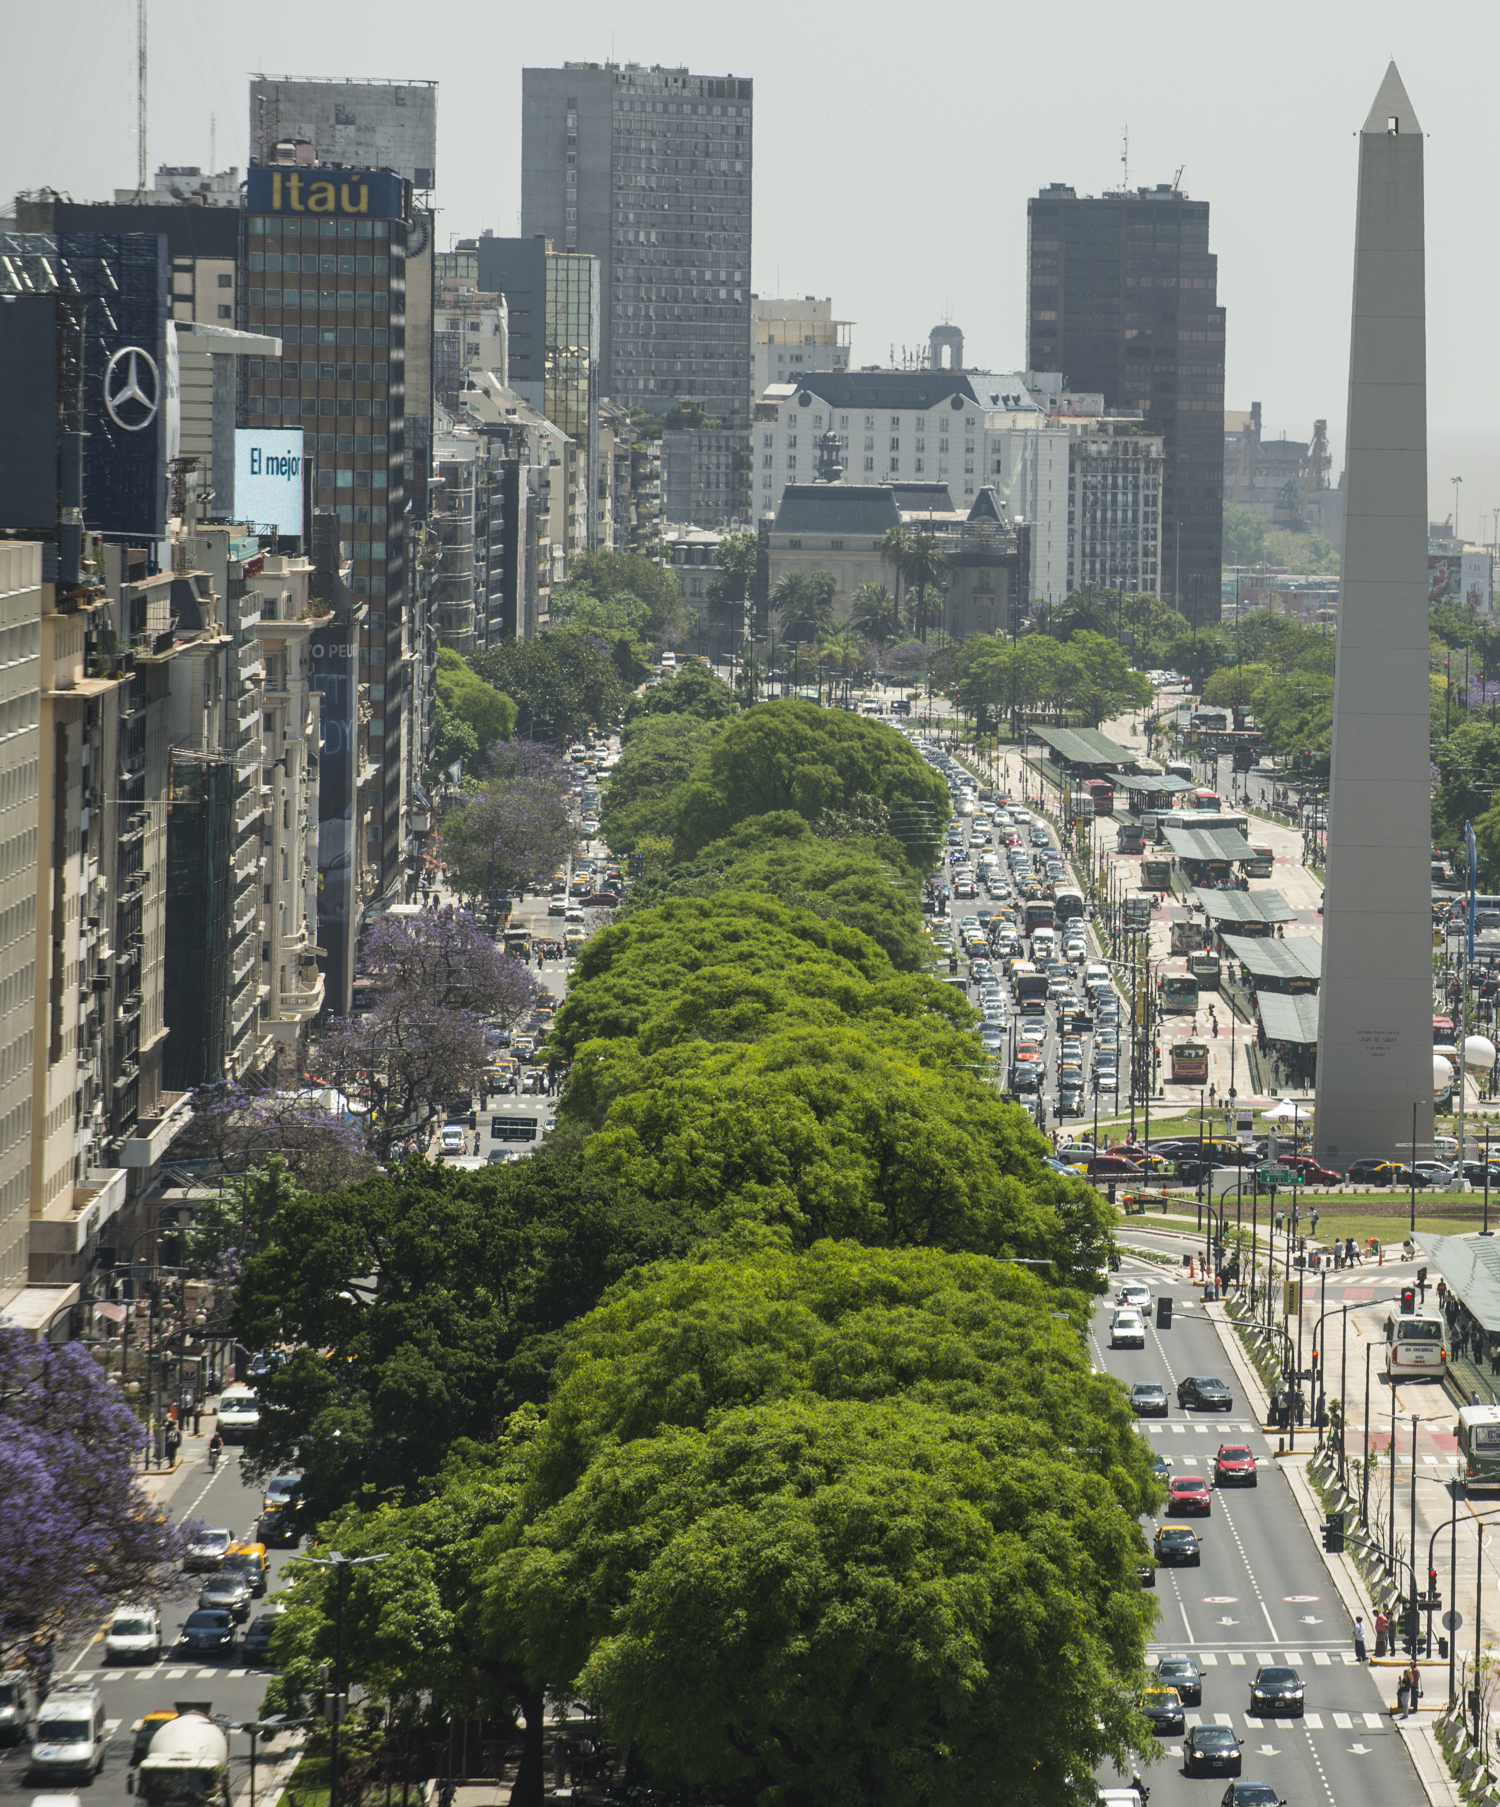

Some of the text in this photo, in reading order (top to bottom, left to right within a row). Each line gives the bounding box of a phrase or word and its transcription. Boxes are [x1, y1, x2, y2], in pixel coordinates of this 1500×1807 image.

[272, 171, 369, 214] Itaú
[250, 447, 301, 482] El mejor
